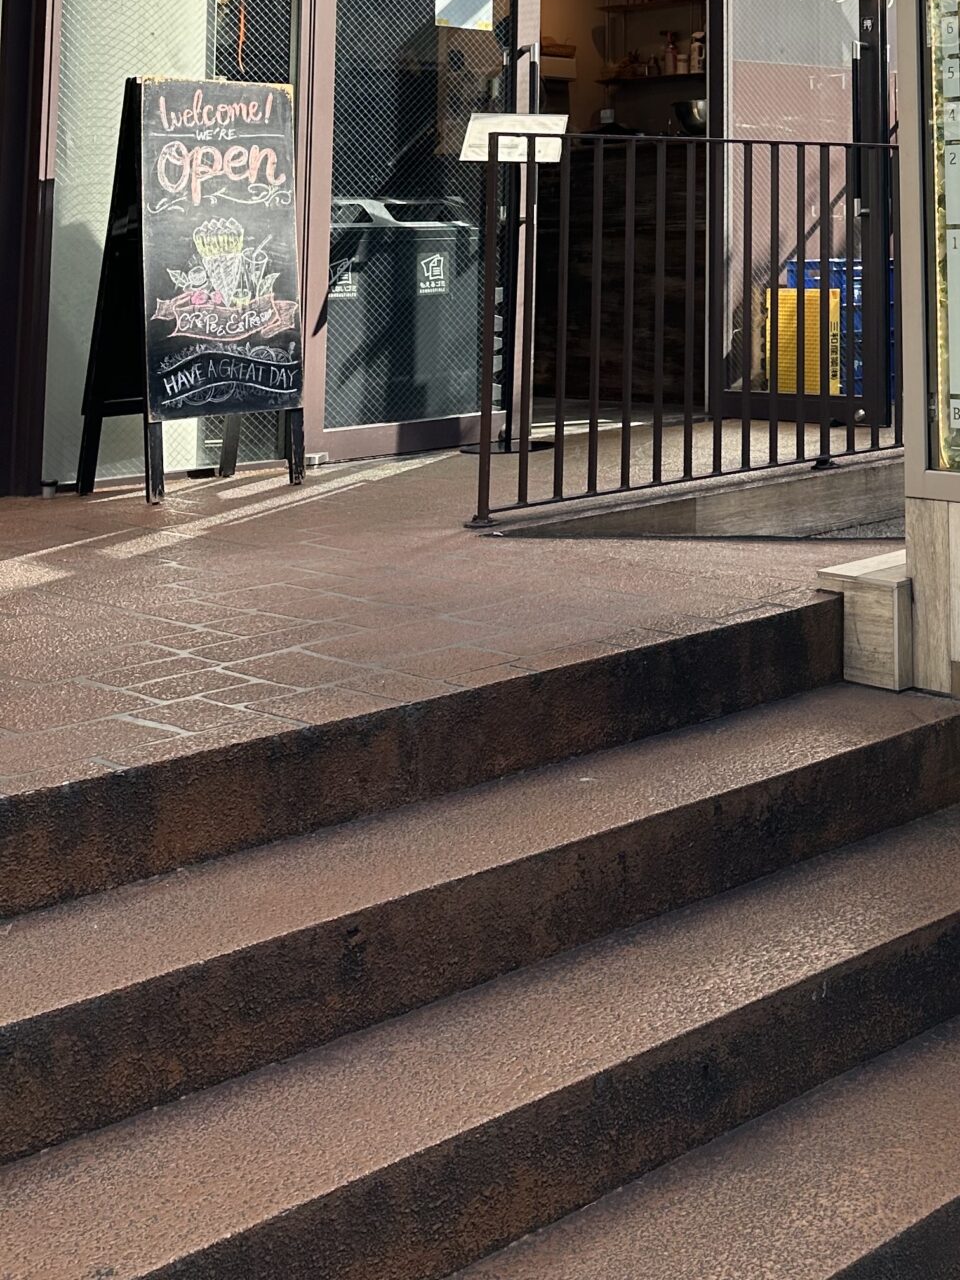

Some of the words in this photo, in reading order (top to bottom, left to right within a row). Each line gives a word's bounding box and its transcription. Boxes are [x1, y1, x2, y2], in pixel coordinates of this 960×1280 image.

[946, 22, 953, 35] 6
[947, 66, 955, 79] 5
[950, 108, 956, 121] 4
[196, 128, 238, 141] WE'RE
[949, 152, 957, 165] 2
[157, 141, 287, 206] Open
[952, 237, 958, 250] 1
[163, 361, 206, 396] HAVE
[208, 360, 218, 379] A
[219, 358, 263, 382] GREAT
[270, 367, 299, 389] DAY
